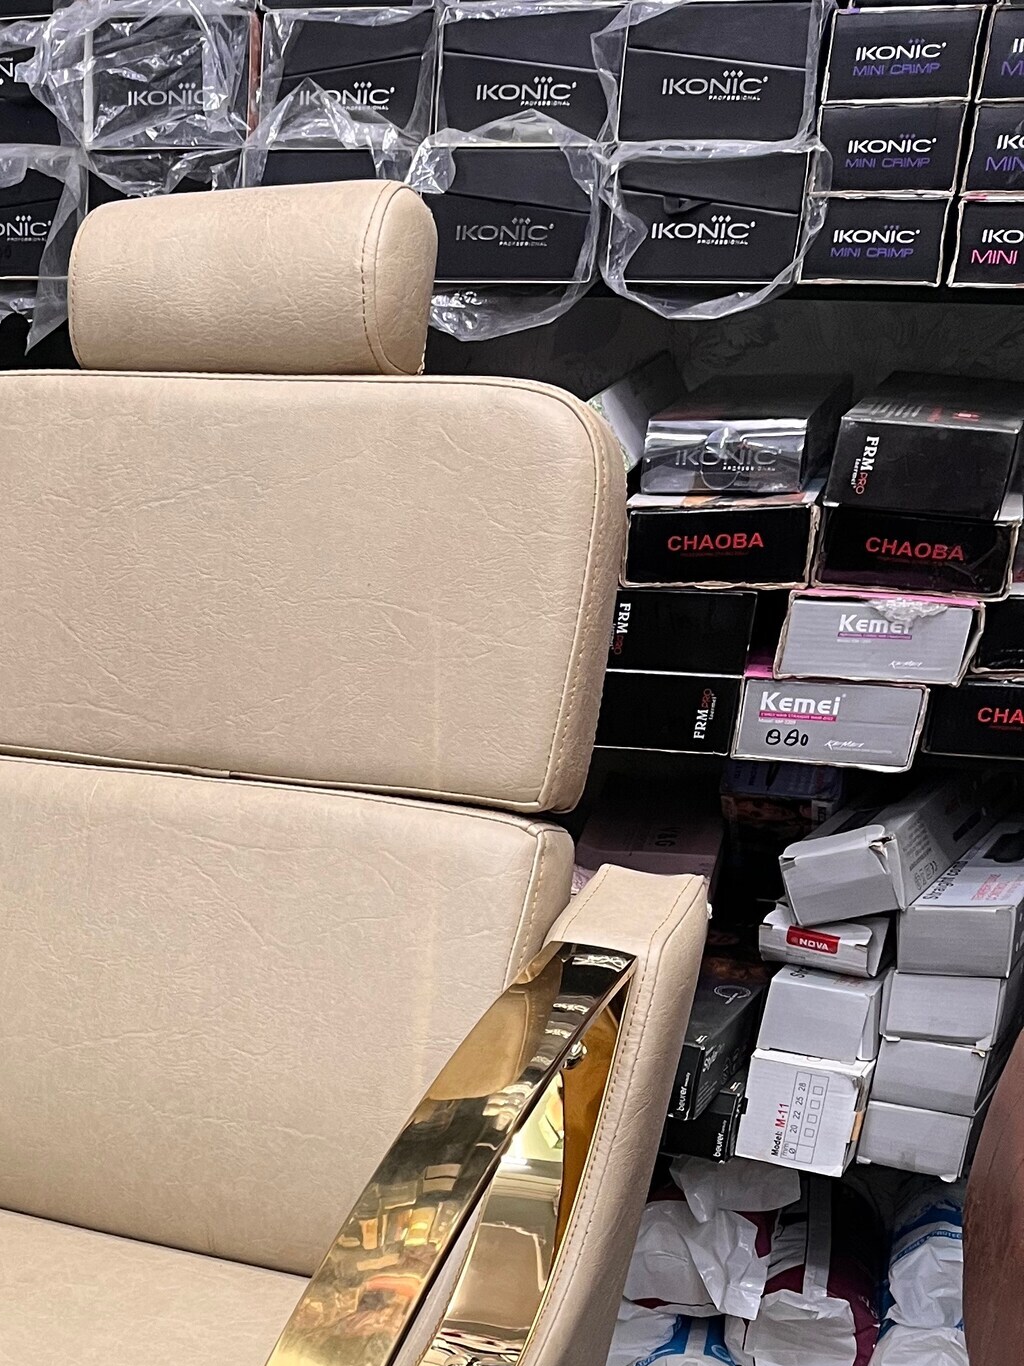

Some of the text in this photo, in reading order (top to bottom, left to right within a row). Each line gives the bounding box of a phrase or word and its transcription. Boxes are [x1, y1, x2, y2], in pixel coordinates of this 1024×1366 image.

[855, 43, 941, 62] IKONIC
[852, 62, 941, 77] MINI CRIMP
[476, 83, 571, 101] IKONIC
[661, 78, 762, 95] IKONIC
[298, 89, 390, 105] IKONIC
[847, 139, 933, 154] IKONIC
[845, 157, 930, 168] MINI CRIMP
[455, 224, 548, 241] IKONIC
[651, 222, 750, 240] IKONIC
[833, 229, 916, 245] IKONIC
[830, 247, 914, 258] MINI CRIMP
[971, 249, 1018, 265] MINI
[855, 436, 880, 495] FRM PRO
[667, 532, 764, 551] CHAOBA
[865, 536, 966, 561] CHAOBA
[616, 602, 632, 634] FRM
[759, 691, 842, 716] Kemei
[693, 709, 709, 740] FRM
[798, 938, 830, 952] NOVA
[676, 1086, 687, 1112] beurer
[790, 1082, 806, 1134] 20 22 25 28
[771, 1103, 790, 1156] Model: M-11
[713, 1132, 724, 1157] beurer
